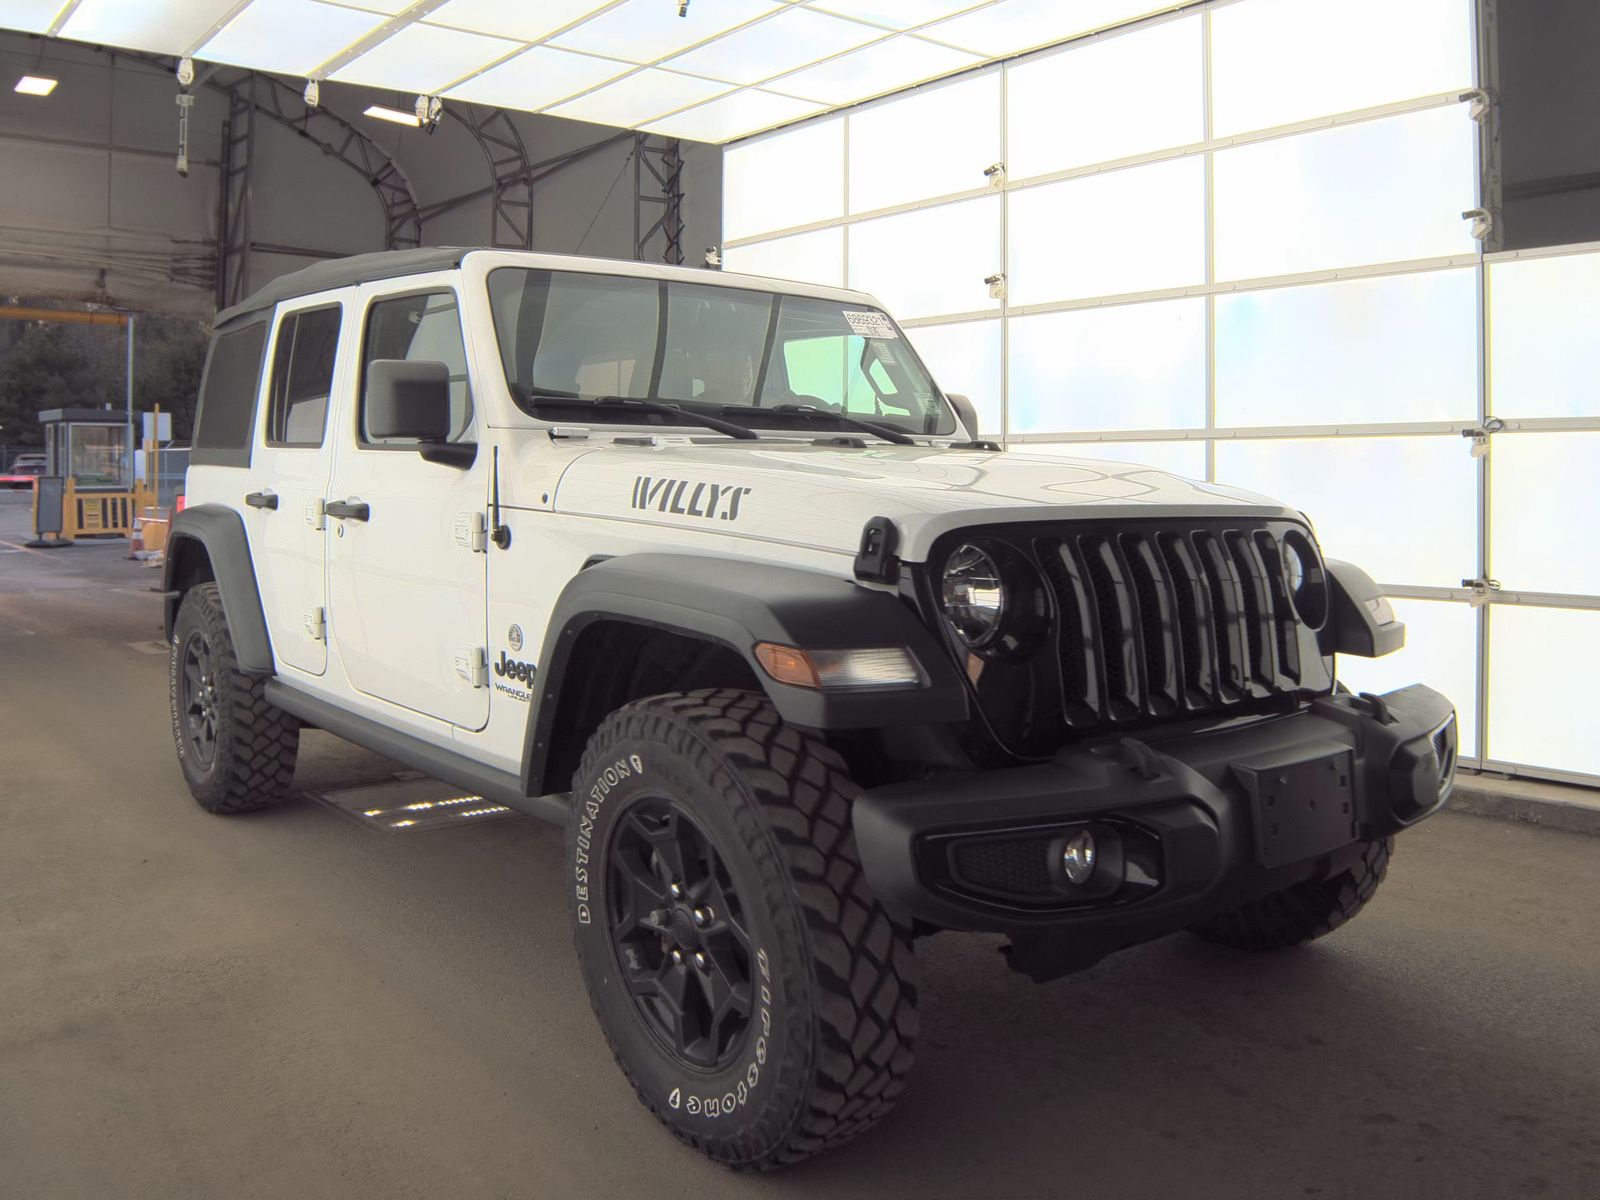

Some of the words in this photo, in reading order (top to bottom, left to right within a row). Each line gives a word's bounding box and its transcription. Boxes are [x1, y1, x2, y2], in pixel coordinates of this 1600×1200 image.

[632, 476, 752, 520] WILLYS
[495, 650, 537, 689] Jeep
[494, 682, 533, 700] WRANGLE
[575, 759, 631, 924] DESTINATION
